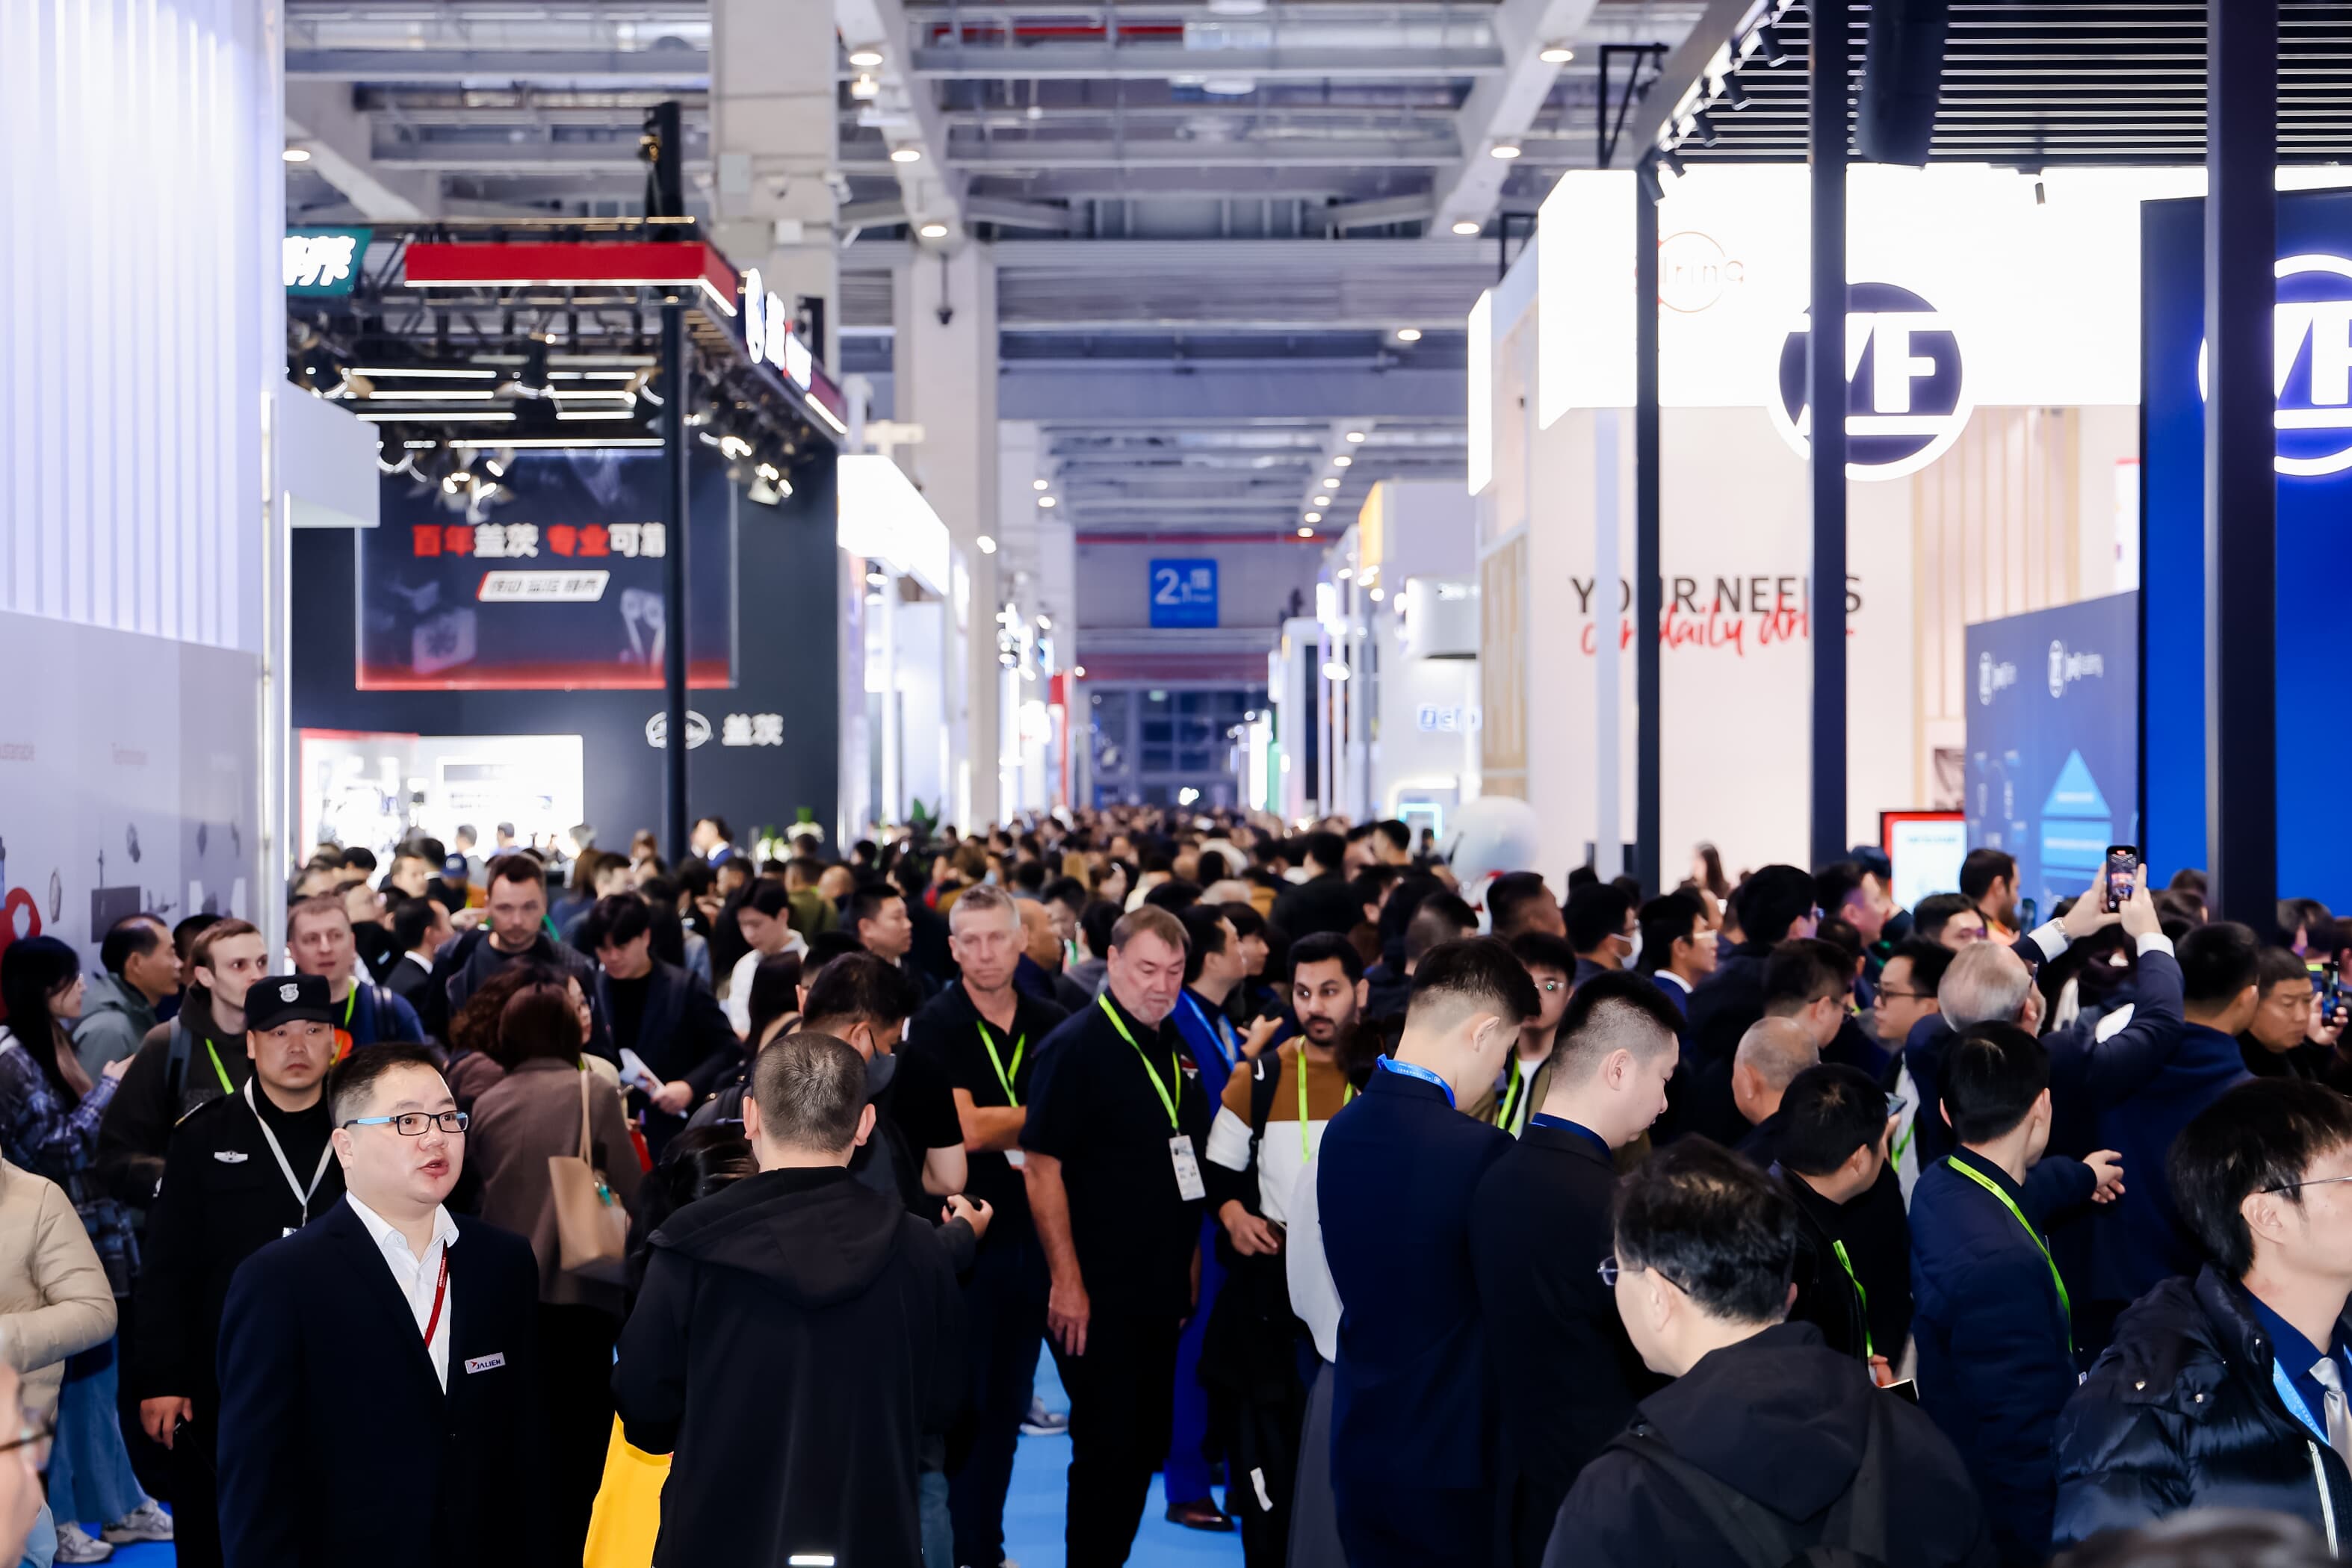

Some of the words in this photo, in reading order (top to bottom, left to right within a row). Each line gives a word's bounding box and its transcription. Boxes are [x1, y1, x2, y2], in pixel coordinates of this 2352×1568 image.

[412, 523, 539, 557] 百年盖茨
[1571, 578, 1697, 613] YR
[1715, 577, 1861, 613] NEES
[722, 713, 784, 746] 盖茨
